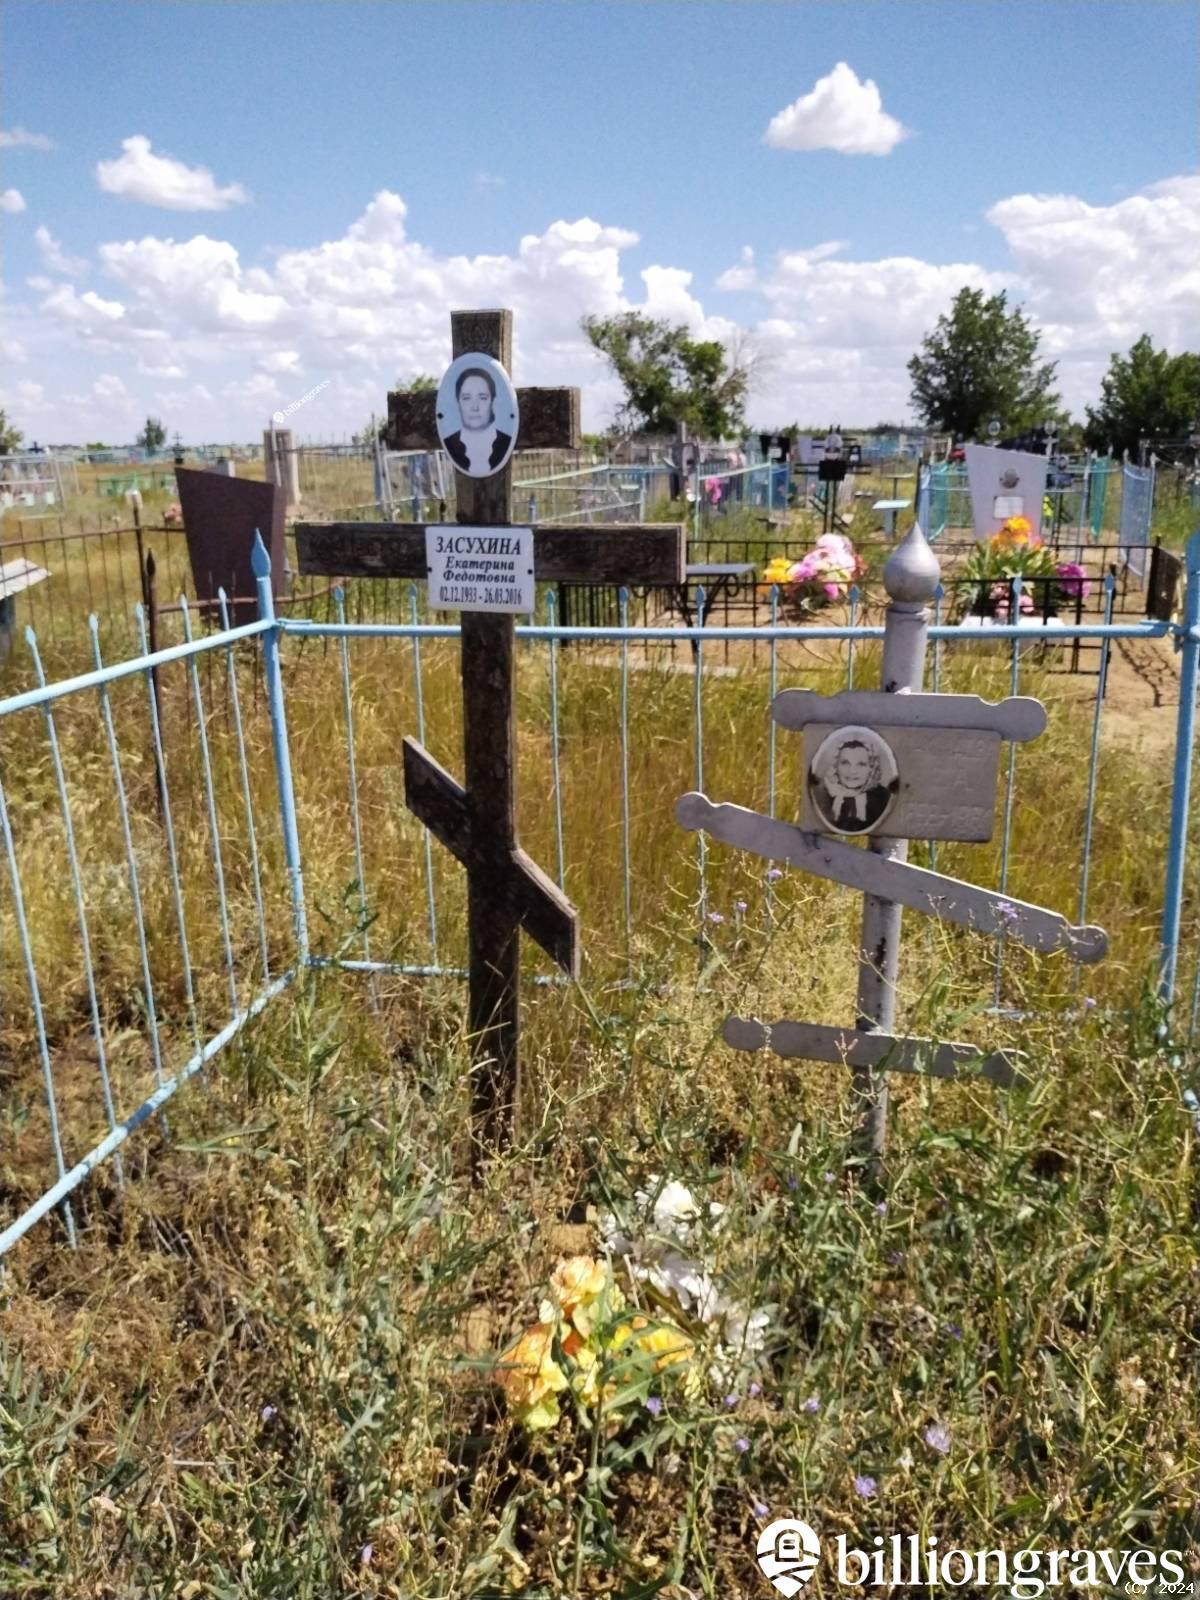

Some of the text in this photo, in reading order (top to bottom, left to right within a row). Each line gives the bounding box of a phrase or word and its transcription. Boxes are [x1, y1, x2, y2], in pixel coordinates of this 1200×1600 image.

[435, 536, 521, 555] ЗАСУХИНА
[445, 555, 515, 573] Екатерина
[442, 569, 516, 584] Федотовна
[439, 586, 478, 603] 02.12.1933
[484, 587, 522, 605] 26.03.2016
